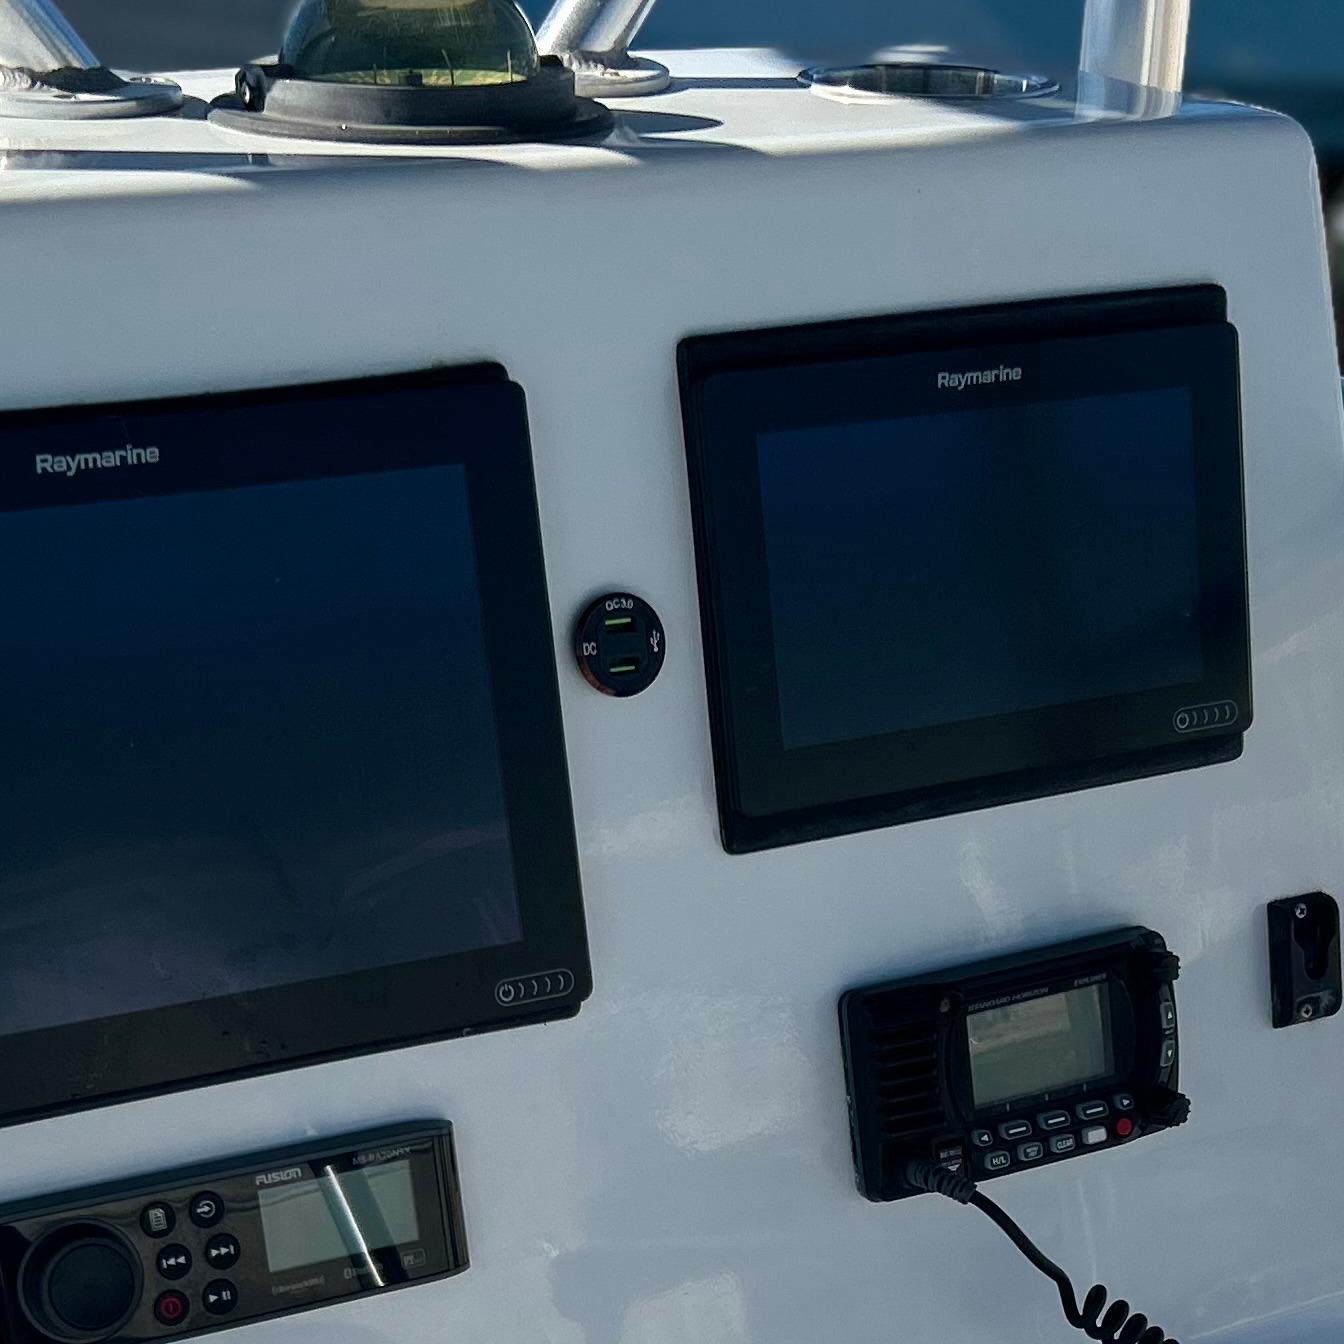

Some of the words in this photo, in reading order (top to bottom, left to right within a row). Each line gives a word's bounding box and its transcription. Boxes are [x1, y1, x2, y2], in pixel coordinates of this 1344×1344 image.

[937, 364, 1022, 391] Raymarine
[35, 444, 160, 476] Raymarine
[582, 642, 597, 656] DC
[992, 1156, 1007, 1166] H/L
[256, 1167, 302, 1186] FUSION
